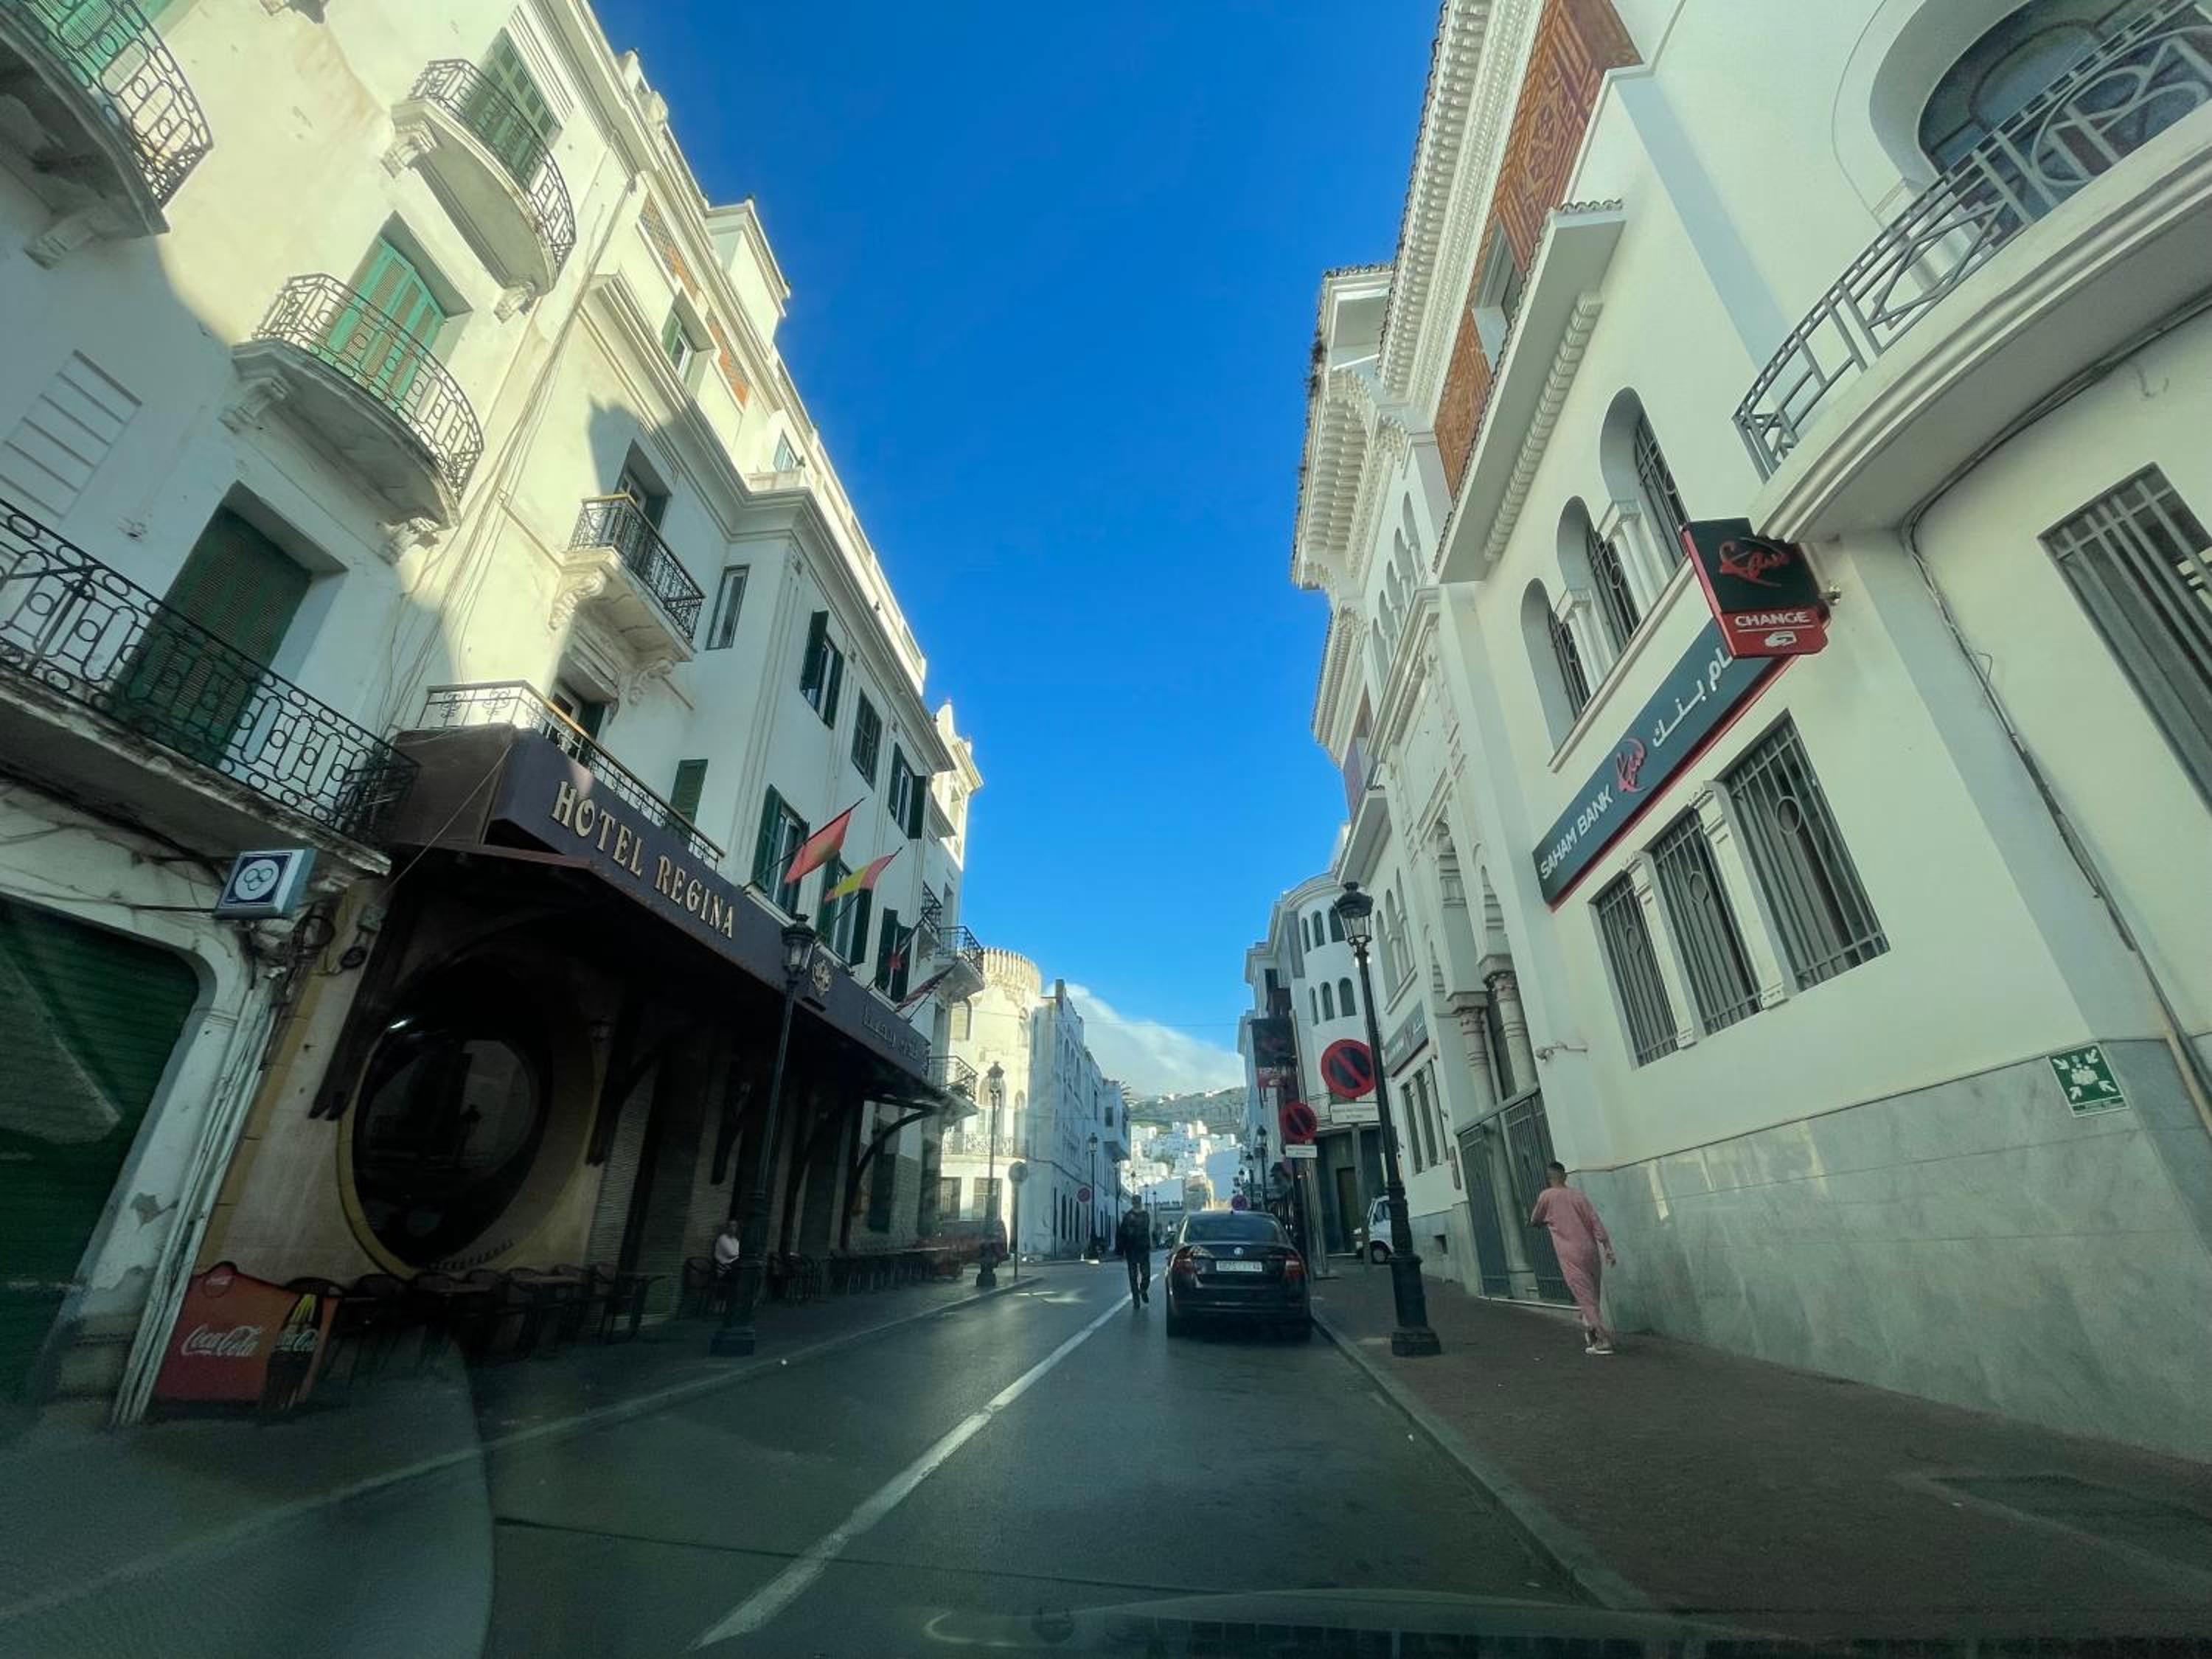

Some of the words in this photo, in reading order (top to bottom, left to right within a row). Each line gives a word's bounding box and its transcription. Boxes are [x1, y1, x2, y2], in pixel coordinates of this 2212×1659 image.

[1735, 611, 1811, 626] CHANGE
[551, 780, 644, 878] HOTEL
[653, 855, 734, 939] REGINA
[1540, 830, 1577, 880] SAHAM
[1577, 785, 1613, 837] BANK
